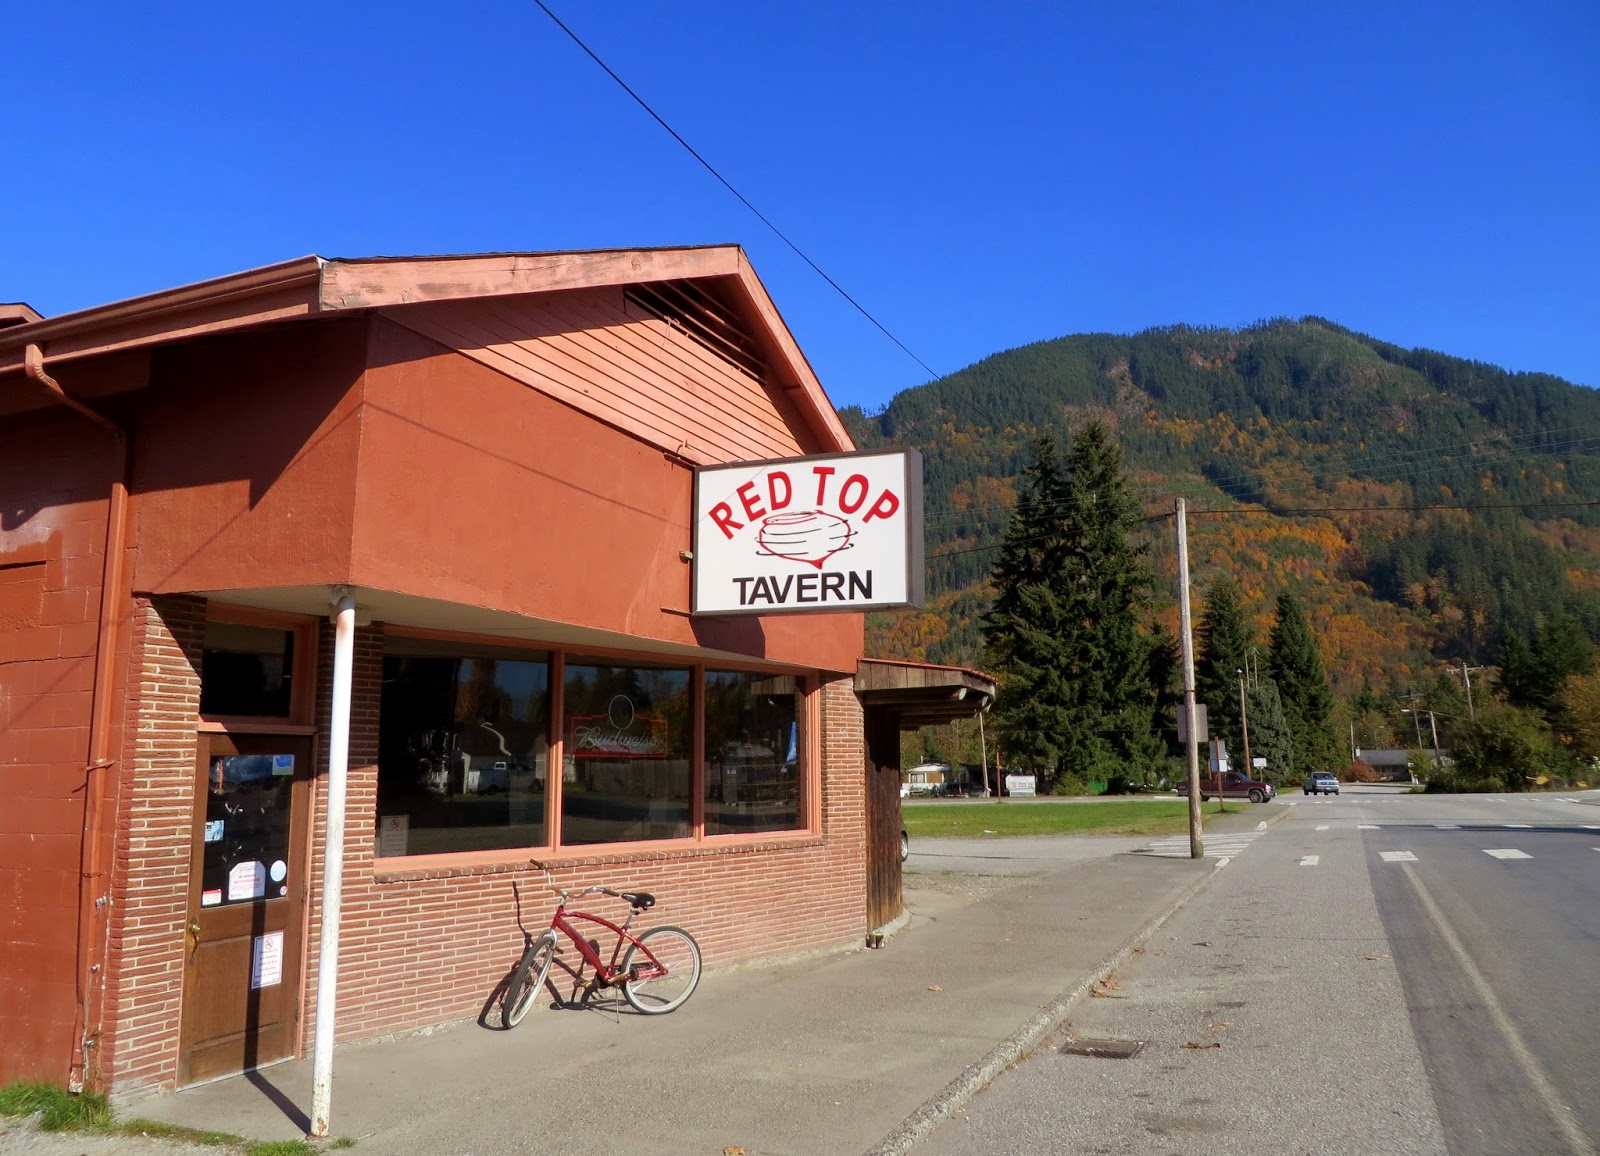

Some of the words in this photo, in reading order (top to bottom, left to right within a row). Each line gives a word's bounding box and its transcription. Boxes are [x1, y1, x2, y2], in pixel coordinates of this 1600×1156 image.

[708, 471, 792, 540] RED
[813, 466, 900, 524] TOP
[732, 569, 873, 605] TAVERN
[574, 726, 664, 748] Budweiser
